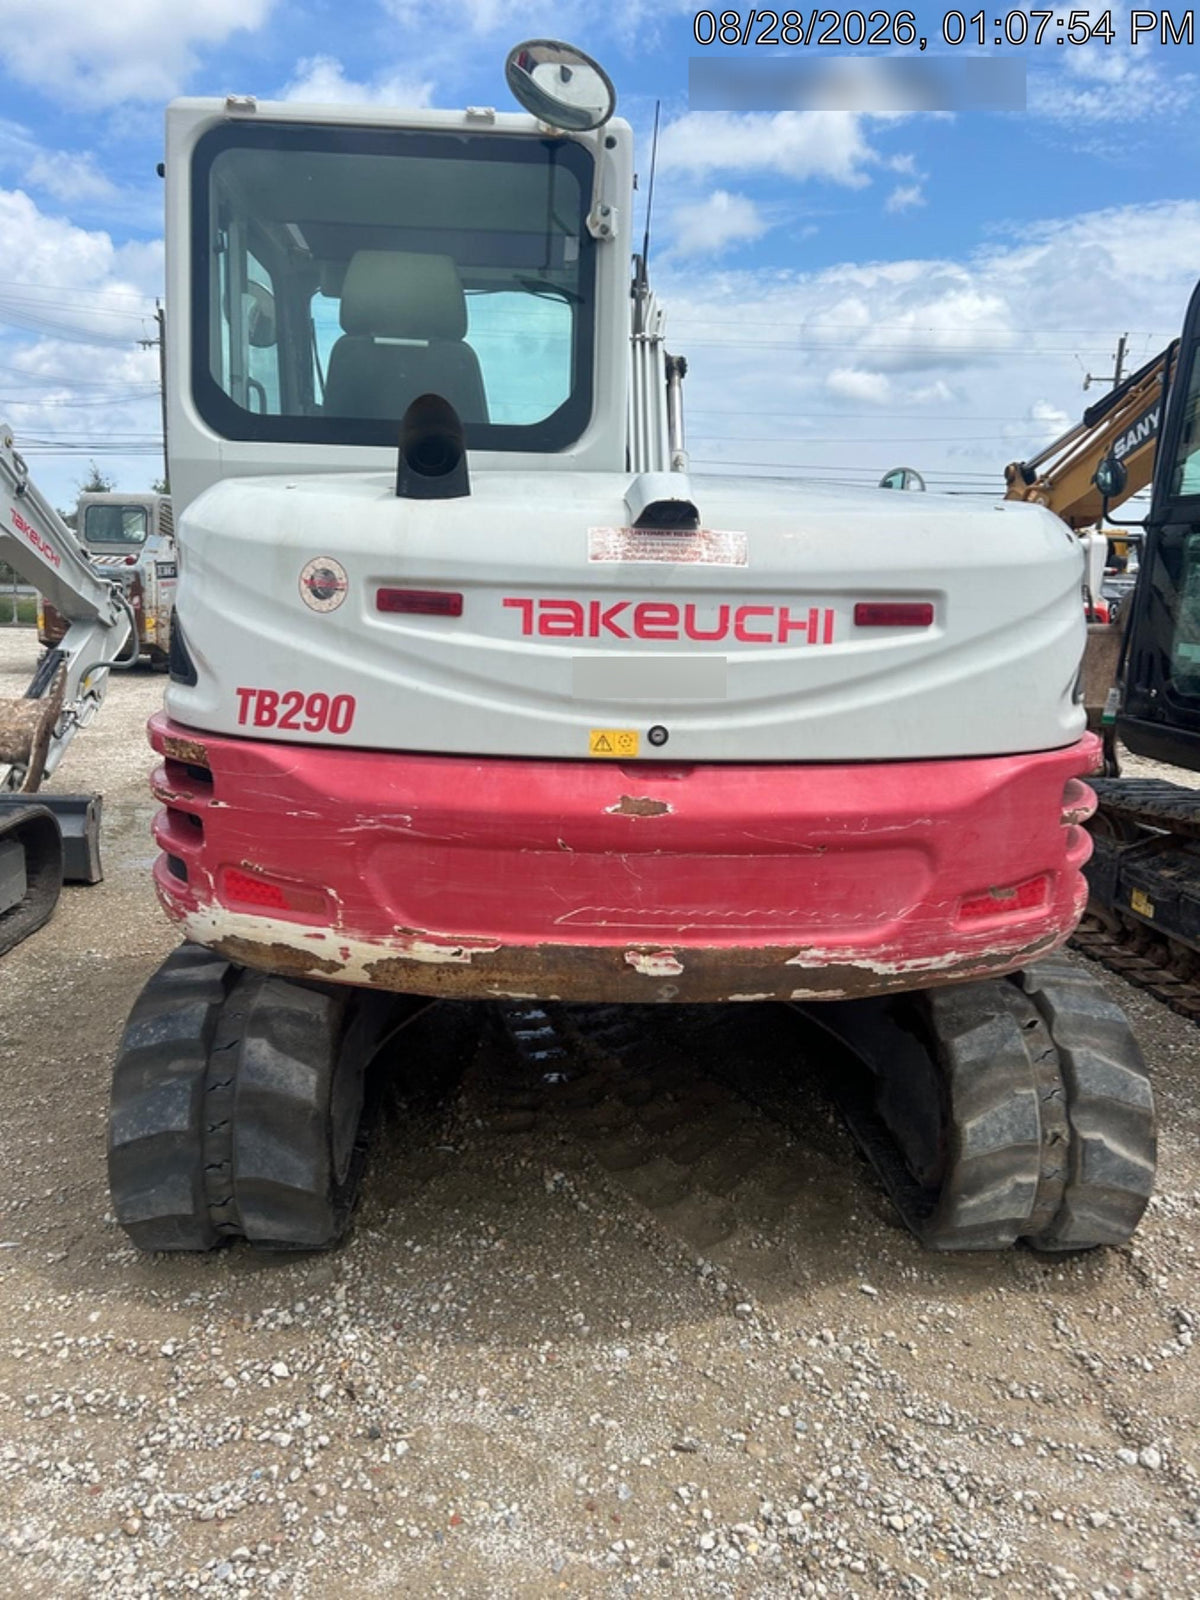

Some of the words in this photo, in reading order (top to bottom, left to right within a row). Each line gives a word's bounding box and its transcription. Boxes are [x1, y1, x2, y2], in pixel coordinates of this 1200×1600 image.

[1113, 406, 1161, 460] SANY
[502, 597, 836, 646] TAKEUCHI
[235, 687, 357, 735] TB290
